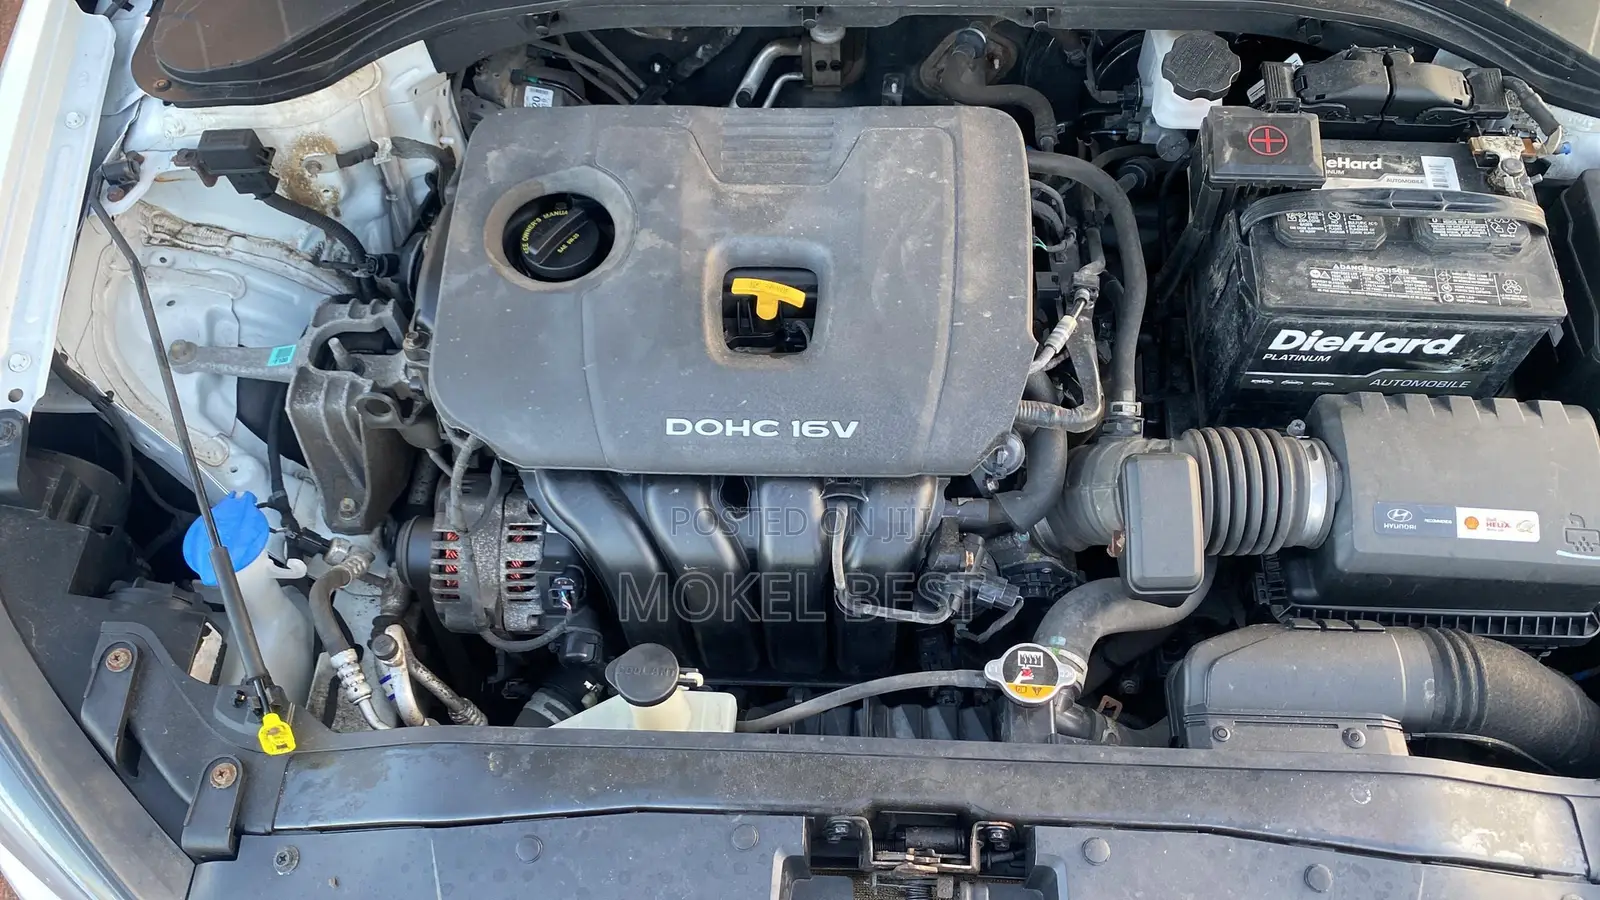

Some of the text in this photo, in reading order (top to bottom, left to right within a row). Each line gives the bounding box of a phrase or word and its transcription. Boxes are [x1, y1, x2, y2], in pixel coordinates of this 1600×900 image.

[1324, 156, 1383, 171] ieHard
[543, 210, 568, 219] MANUA
[1267, 328, 1466, 355] DieHard
[1262, 353, 1332, 363] PLATINUM
[1369, 378, 1472, 389] AUTOMOBILE
[665, 418, 860, 439] DOHC 16V
[1383, 522, 1417, 530] HYUNDAI
[1486, 521, 1511, 530] HELIX
[618, 663, 676, 678] COOLANT
